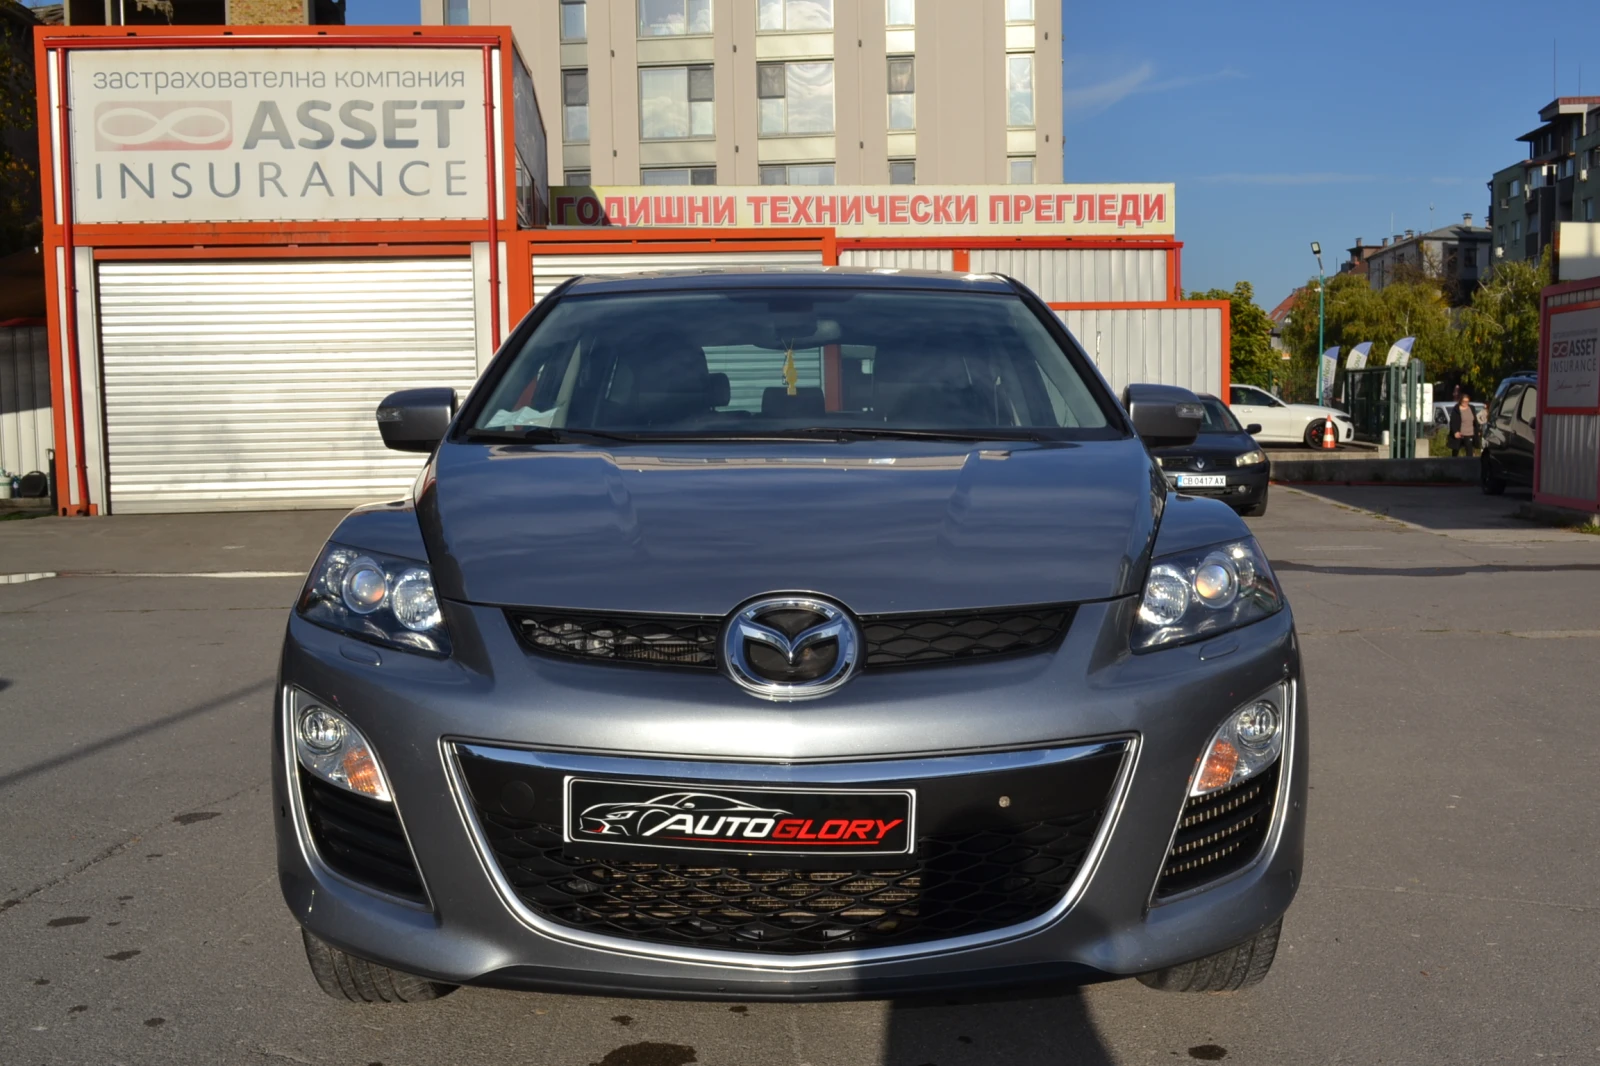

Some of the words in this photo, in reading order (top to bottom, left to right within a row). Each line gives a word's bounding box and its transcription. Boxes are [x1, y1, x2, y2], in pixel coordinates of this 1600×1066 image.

[92, 70, 326, 95] застрахователна
[335, 70, 465, 89] компания
[242, 100, 466, 150] ASSET
[95, 159, 468, 199] INSURANCE
[555, 196, 737, 227] ГОДИШНИ
[746, 195, 978, 224] ТЕХНИЧЕСКИ
[988, 194, 1166, 227] ПРЕГЛЕДИ
[1568, 338, 1598, 357] ASSET
[1550, 358, 1597, 373] INSURANCE
[1194, 477, 1213, 485] 0417
[1214, 477, 1224, 485] AX
